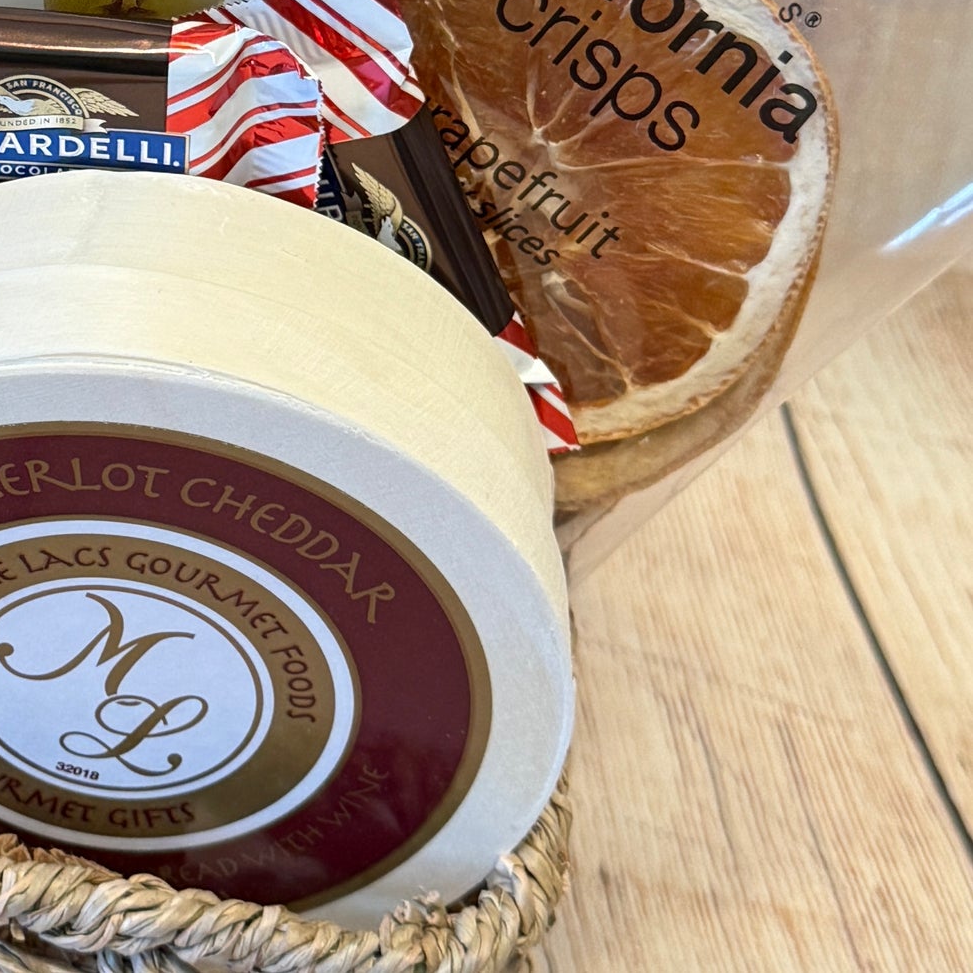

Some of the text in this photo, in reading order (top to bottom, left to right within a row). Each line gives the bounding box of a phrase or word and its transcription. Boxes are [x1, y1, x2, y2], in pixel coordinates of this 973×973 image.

[6, 80, 83, 116] SAN FRANCISCO
[39, 117, 50, 125] IN
[55, 116, 78, 125] 1852
[427, 97, 620, 259] rapefruit
[180, 477, 396, 624] CHEDDAR
[19, 546, 112, 574] LACS
[127, 551, 288, 640] GOURMET
[270, 644, 316, 724] FOODS
[55, 761, 100, 781] 32018
[318, 763, 390, 827] WINE
[108, 801, 196, 828] GIFTS
